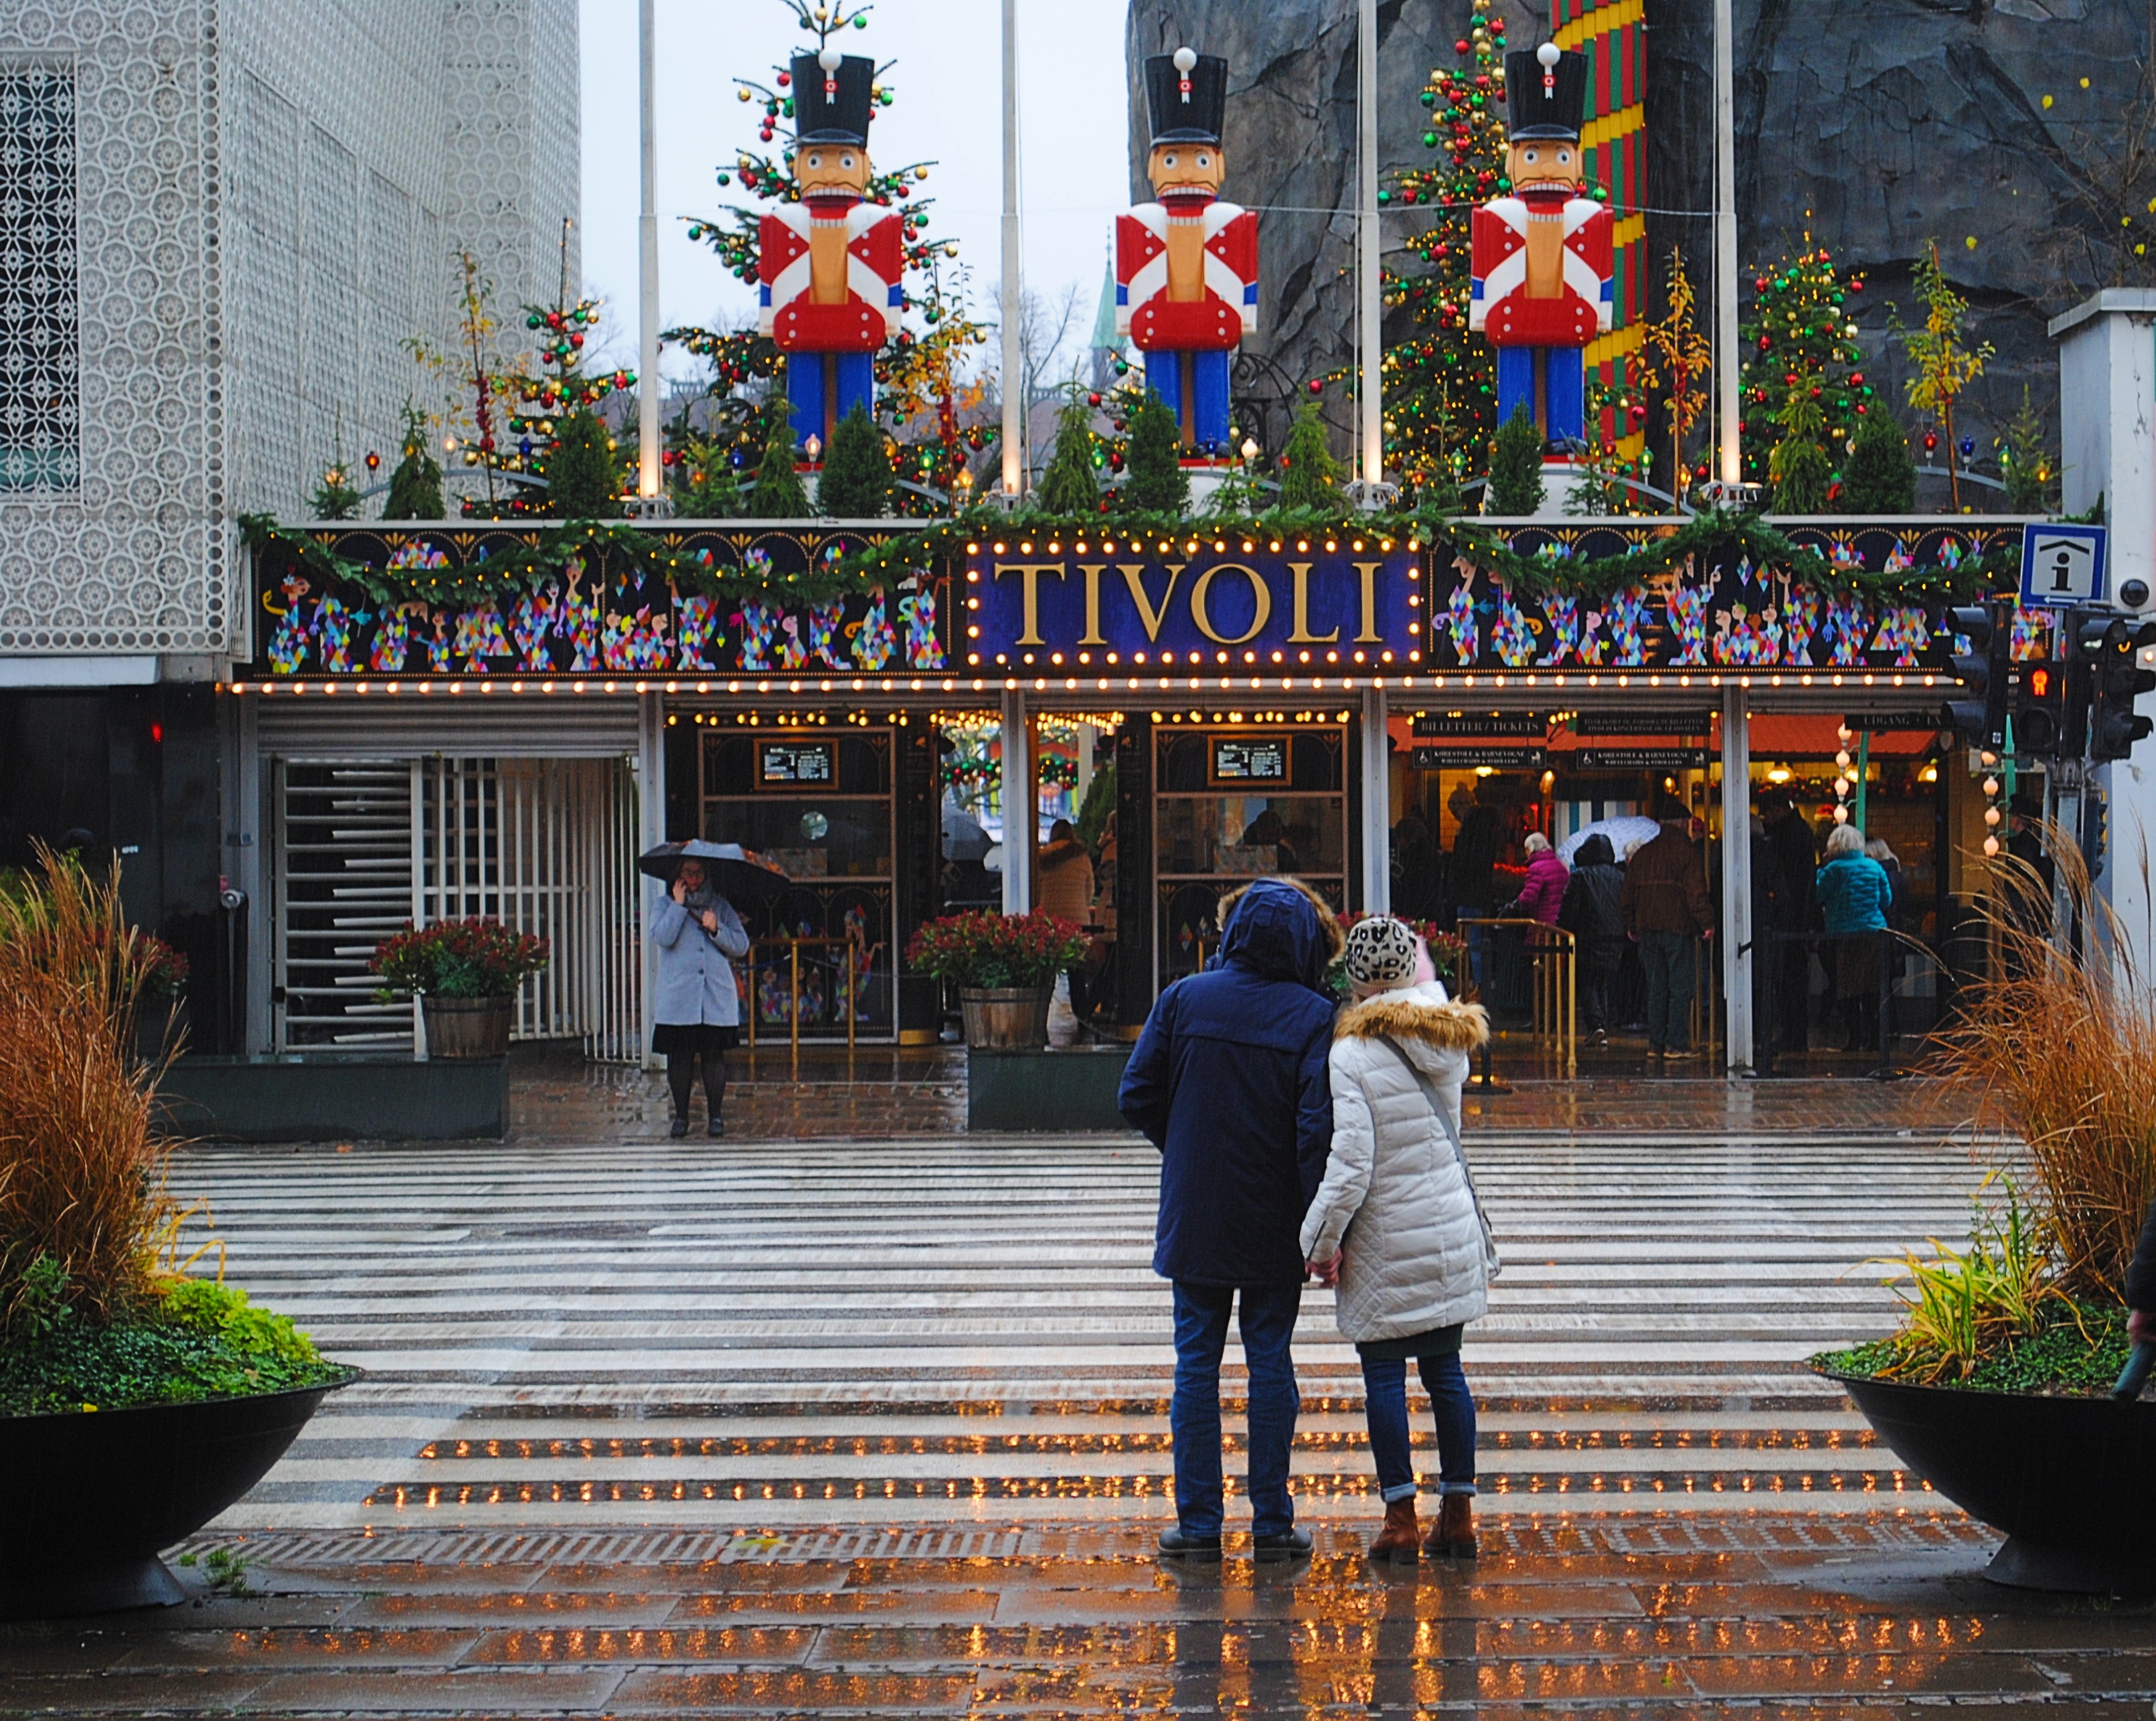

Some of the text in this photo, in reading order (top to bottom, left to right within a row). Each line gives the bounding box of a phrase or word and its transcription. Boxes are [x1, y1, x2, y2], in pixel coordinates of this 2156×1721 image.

[994, 562, 1384, 645] TIVOLI
[1421, 721, 1482, 732] BILLETTER
[1493, 721, 1539, 732] TICKETS
